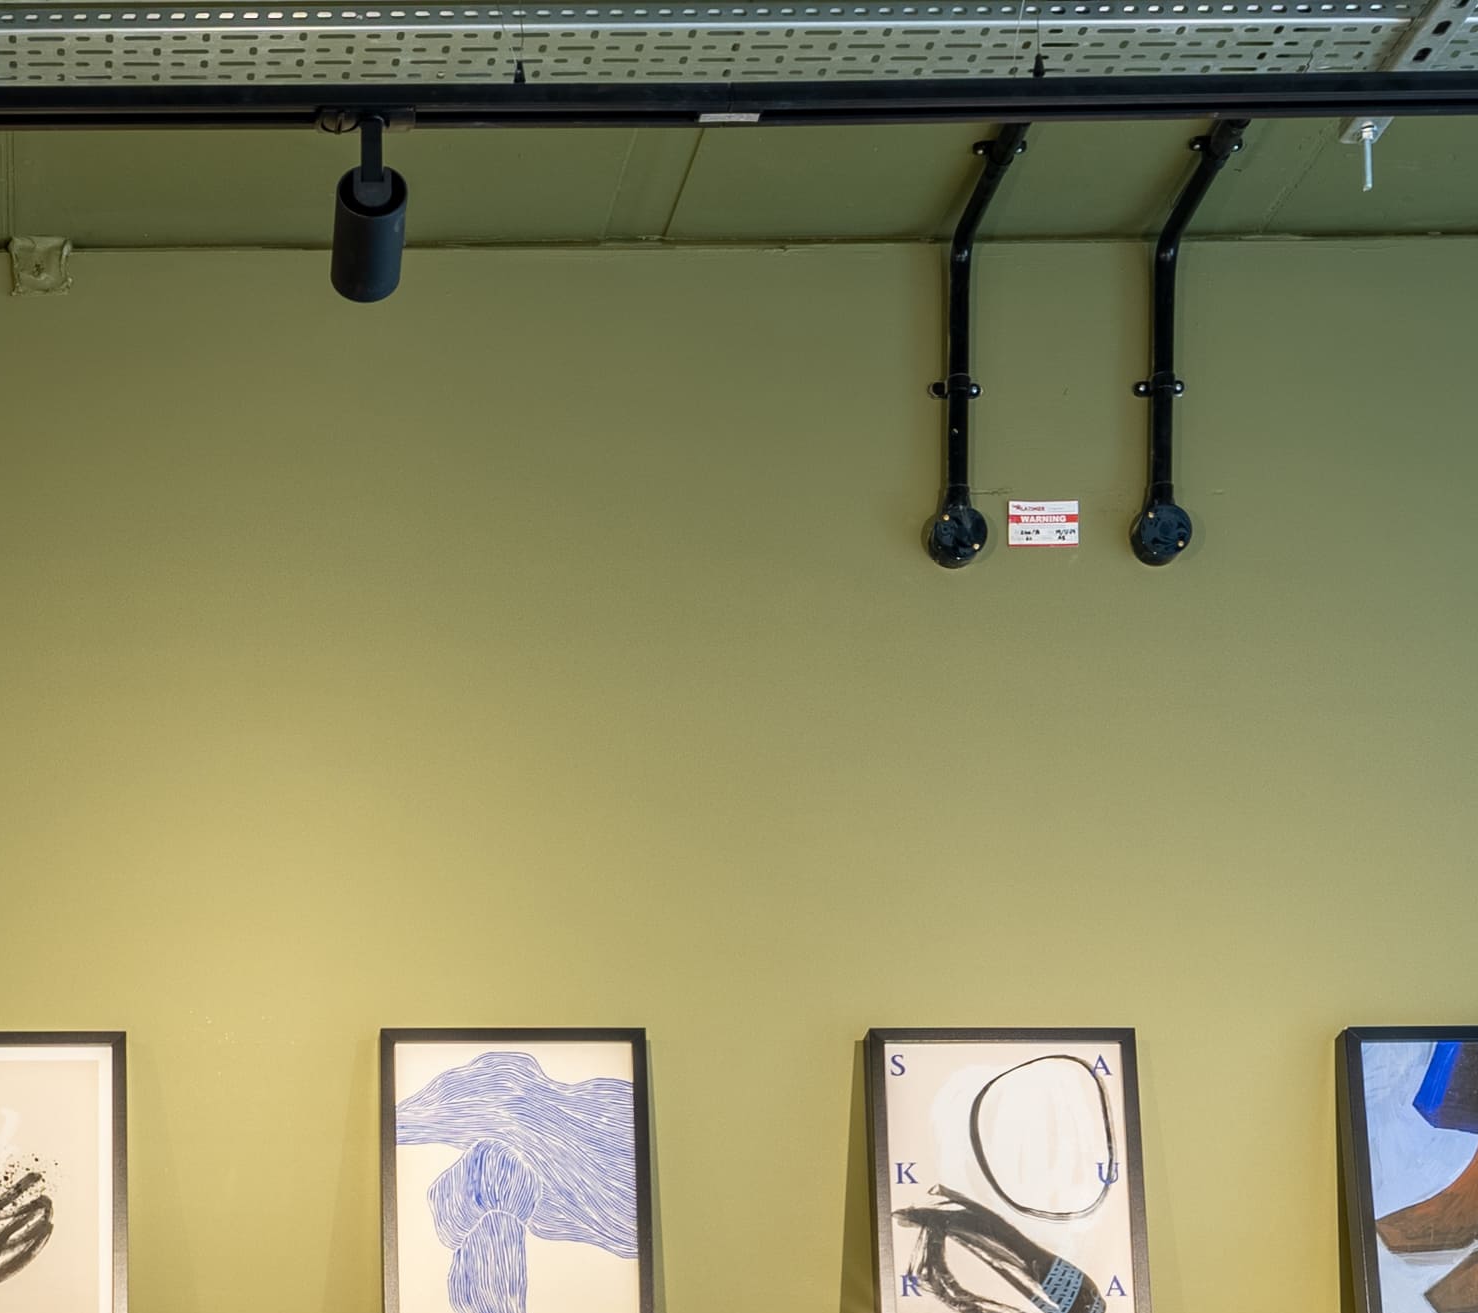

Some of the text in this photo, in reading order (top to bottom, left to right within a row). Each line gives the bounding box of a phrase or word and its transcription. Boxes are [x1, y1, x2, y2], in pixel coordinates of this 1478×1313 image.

[1021, 515, 1066, 523] WARNING
[891, 1054, 1111, 1076] S A
[895, 1162, 1119, 1185] K U
[901, 1275, 1127, 1297] R A
